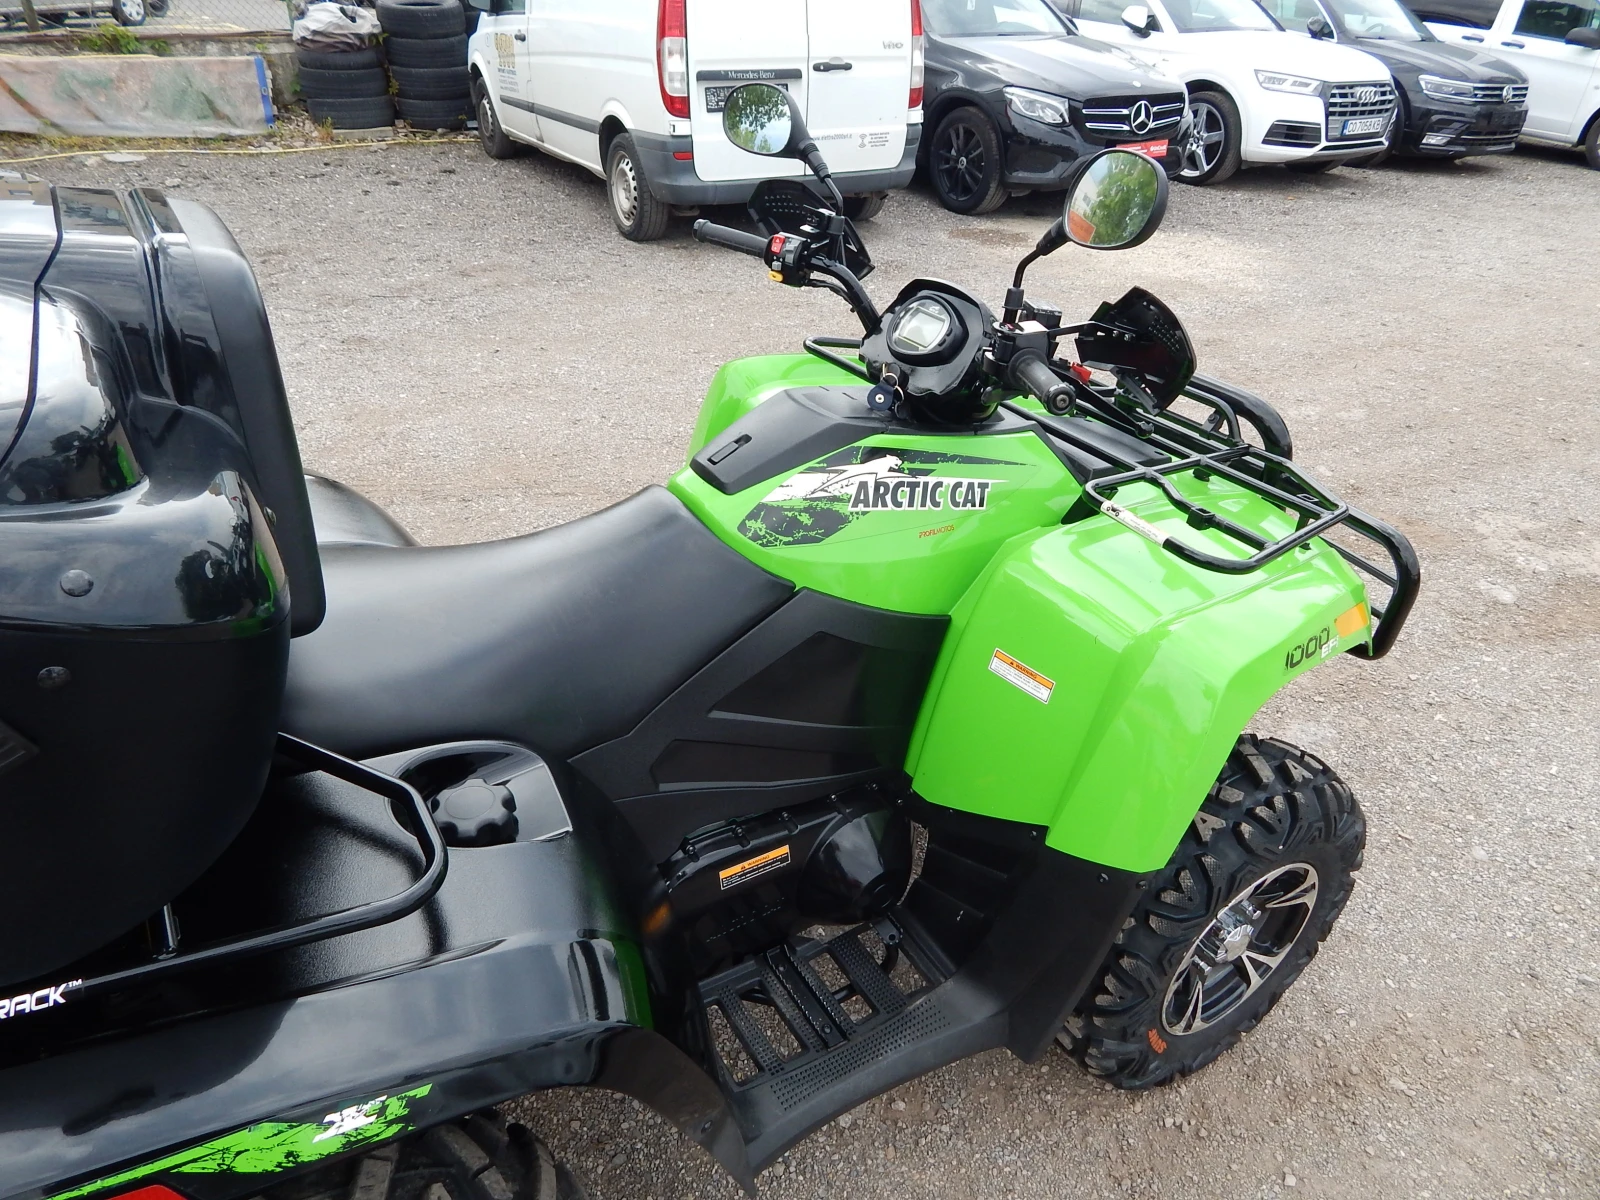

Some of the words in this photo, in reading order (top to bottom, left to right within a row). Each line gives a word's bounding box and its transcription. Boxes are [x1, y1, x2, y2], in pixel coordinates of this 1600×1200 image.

[728, 70, 776, 79] Mercedes-Benz
[849, 480, 945, 509] ARCTIC
[948, 480, 990, 509] CAT
[1284, 627, 1331, 671] 1000
[1014, 662, 1038, 680] WARNING
